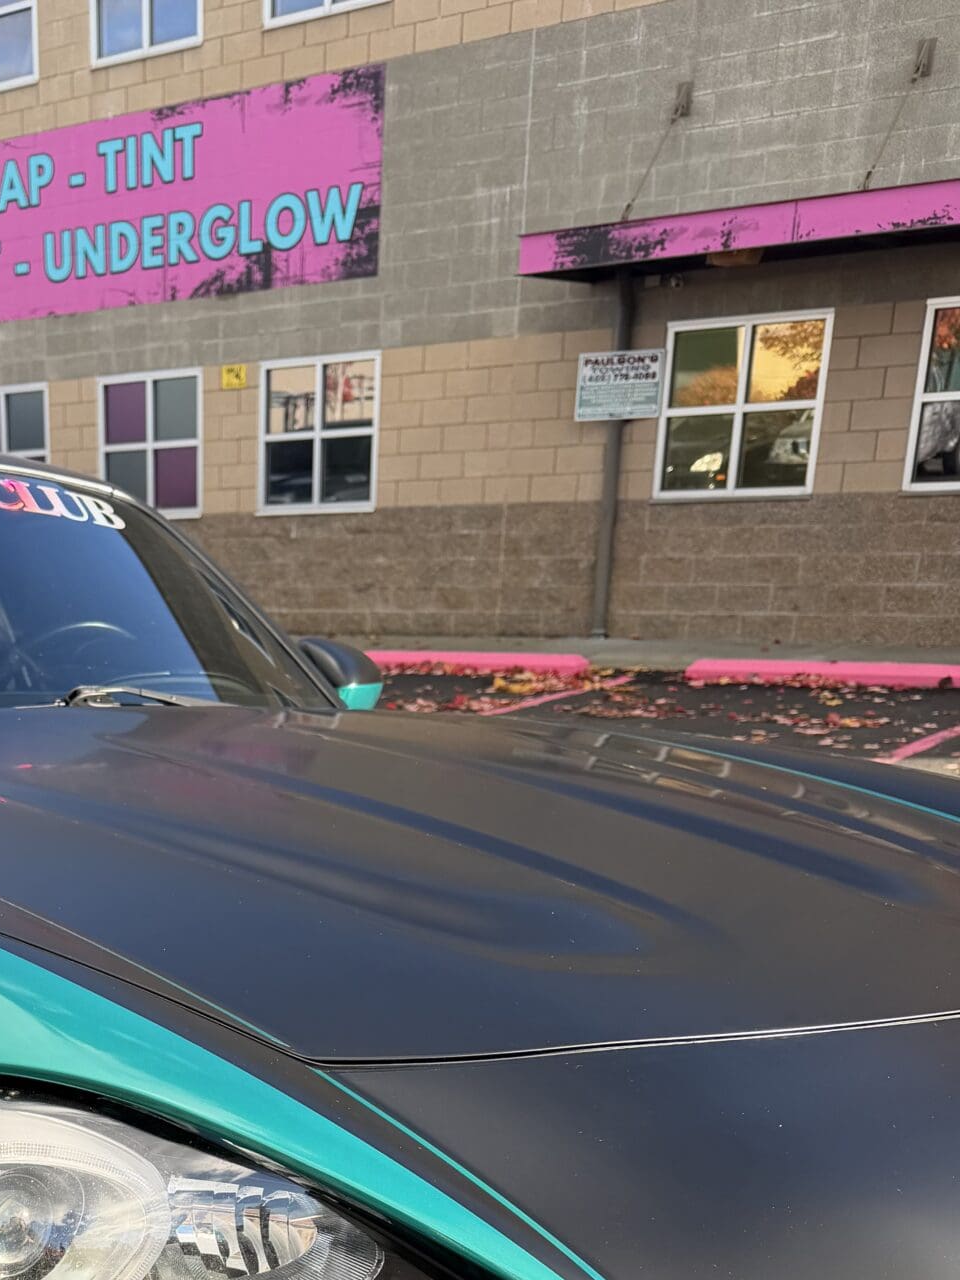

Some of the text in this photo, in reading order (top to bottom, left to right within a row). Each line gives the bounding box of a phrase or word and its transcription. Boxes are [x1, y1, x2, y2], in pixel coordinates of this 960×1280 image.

[70, 173, 86, 188] -
[97, 122, 203, 194] TINT
[15, 262, 30, 276] -
[44, 182, 362, 283] UNDERGLOW
